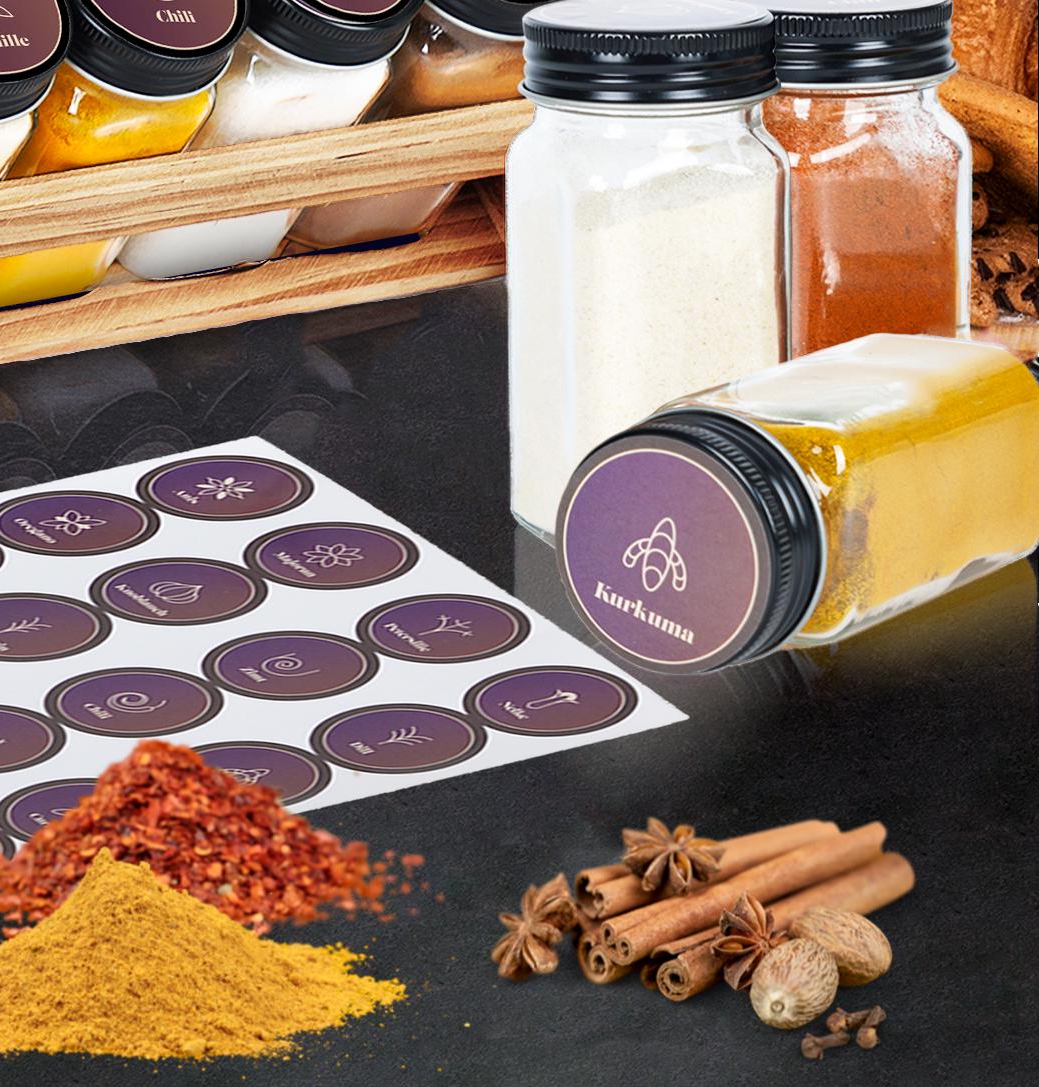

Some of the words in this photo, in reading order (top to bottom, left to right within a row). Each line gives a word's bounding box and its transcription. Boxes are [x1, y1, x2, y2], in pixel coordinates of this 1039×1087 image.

[156, 9, 197, 24] Chili
[14, 517, 57, 544] Oregano
[272, 550, 316, 579] Majoran
[593, 580, 696, 645] Kurkuma
